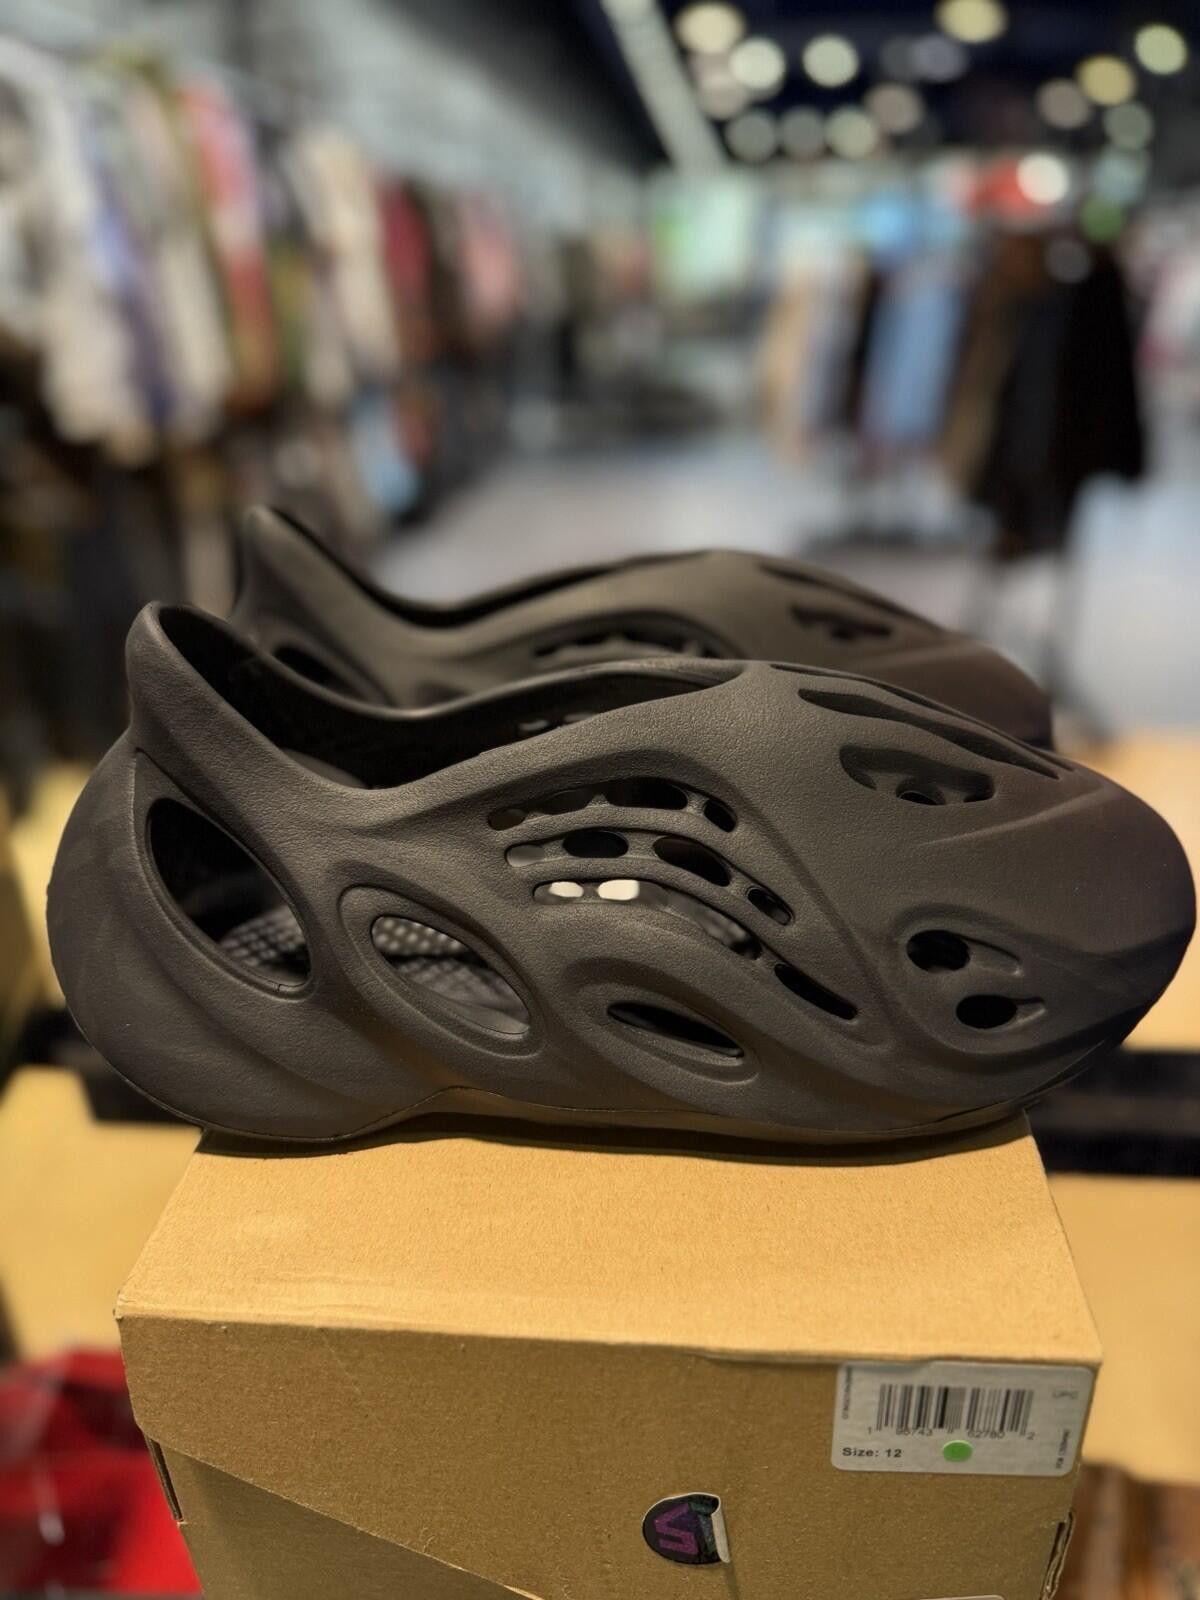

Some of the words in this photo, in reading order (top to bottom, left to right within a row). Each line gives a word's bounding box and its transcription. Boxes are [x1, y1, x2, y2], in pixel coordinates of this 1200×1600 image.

[1027, 1432, 1035, 1440] 2
[842, 1447, 880, 1458] Size:
[884, 1448, 902, 1458] 12
